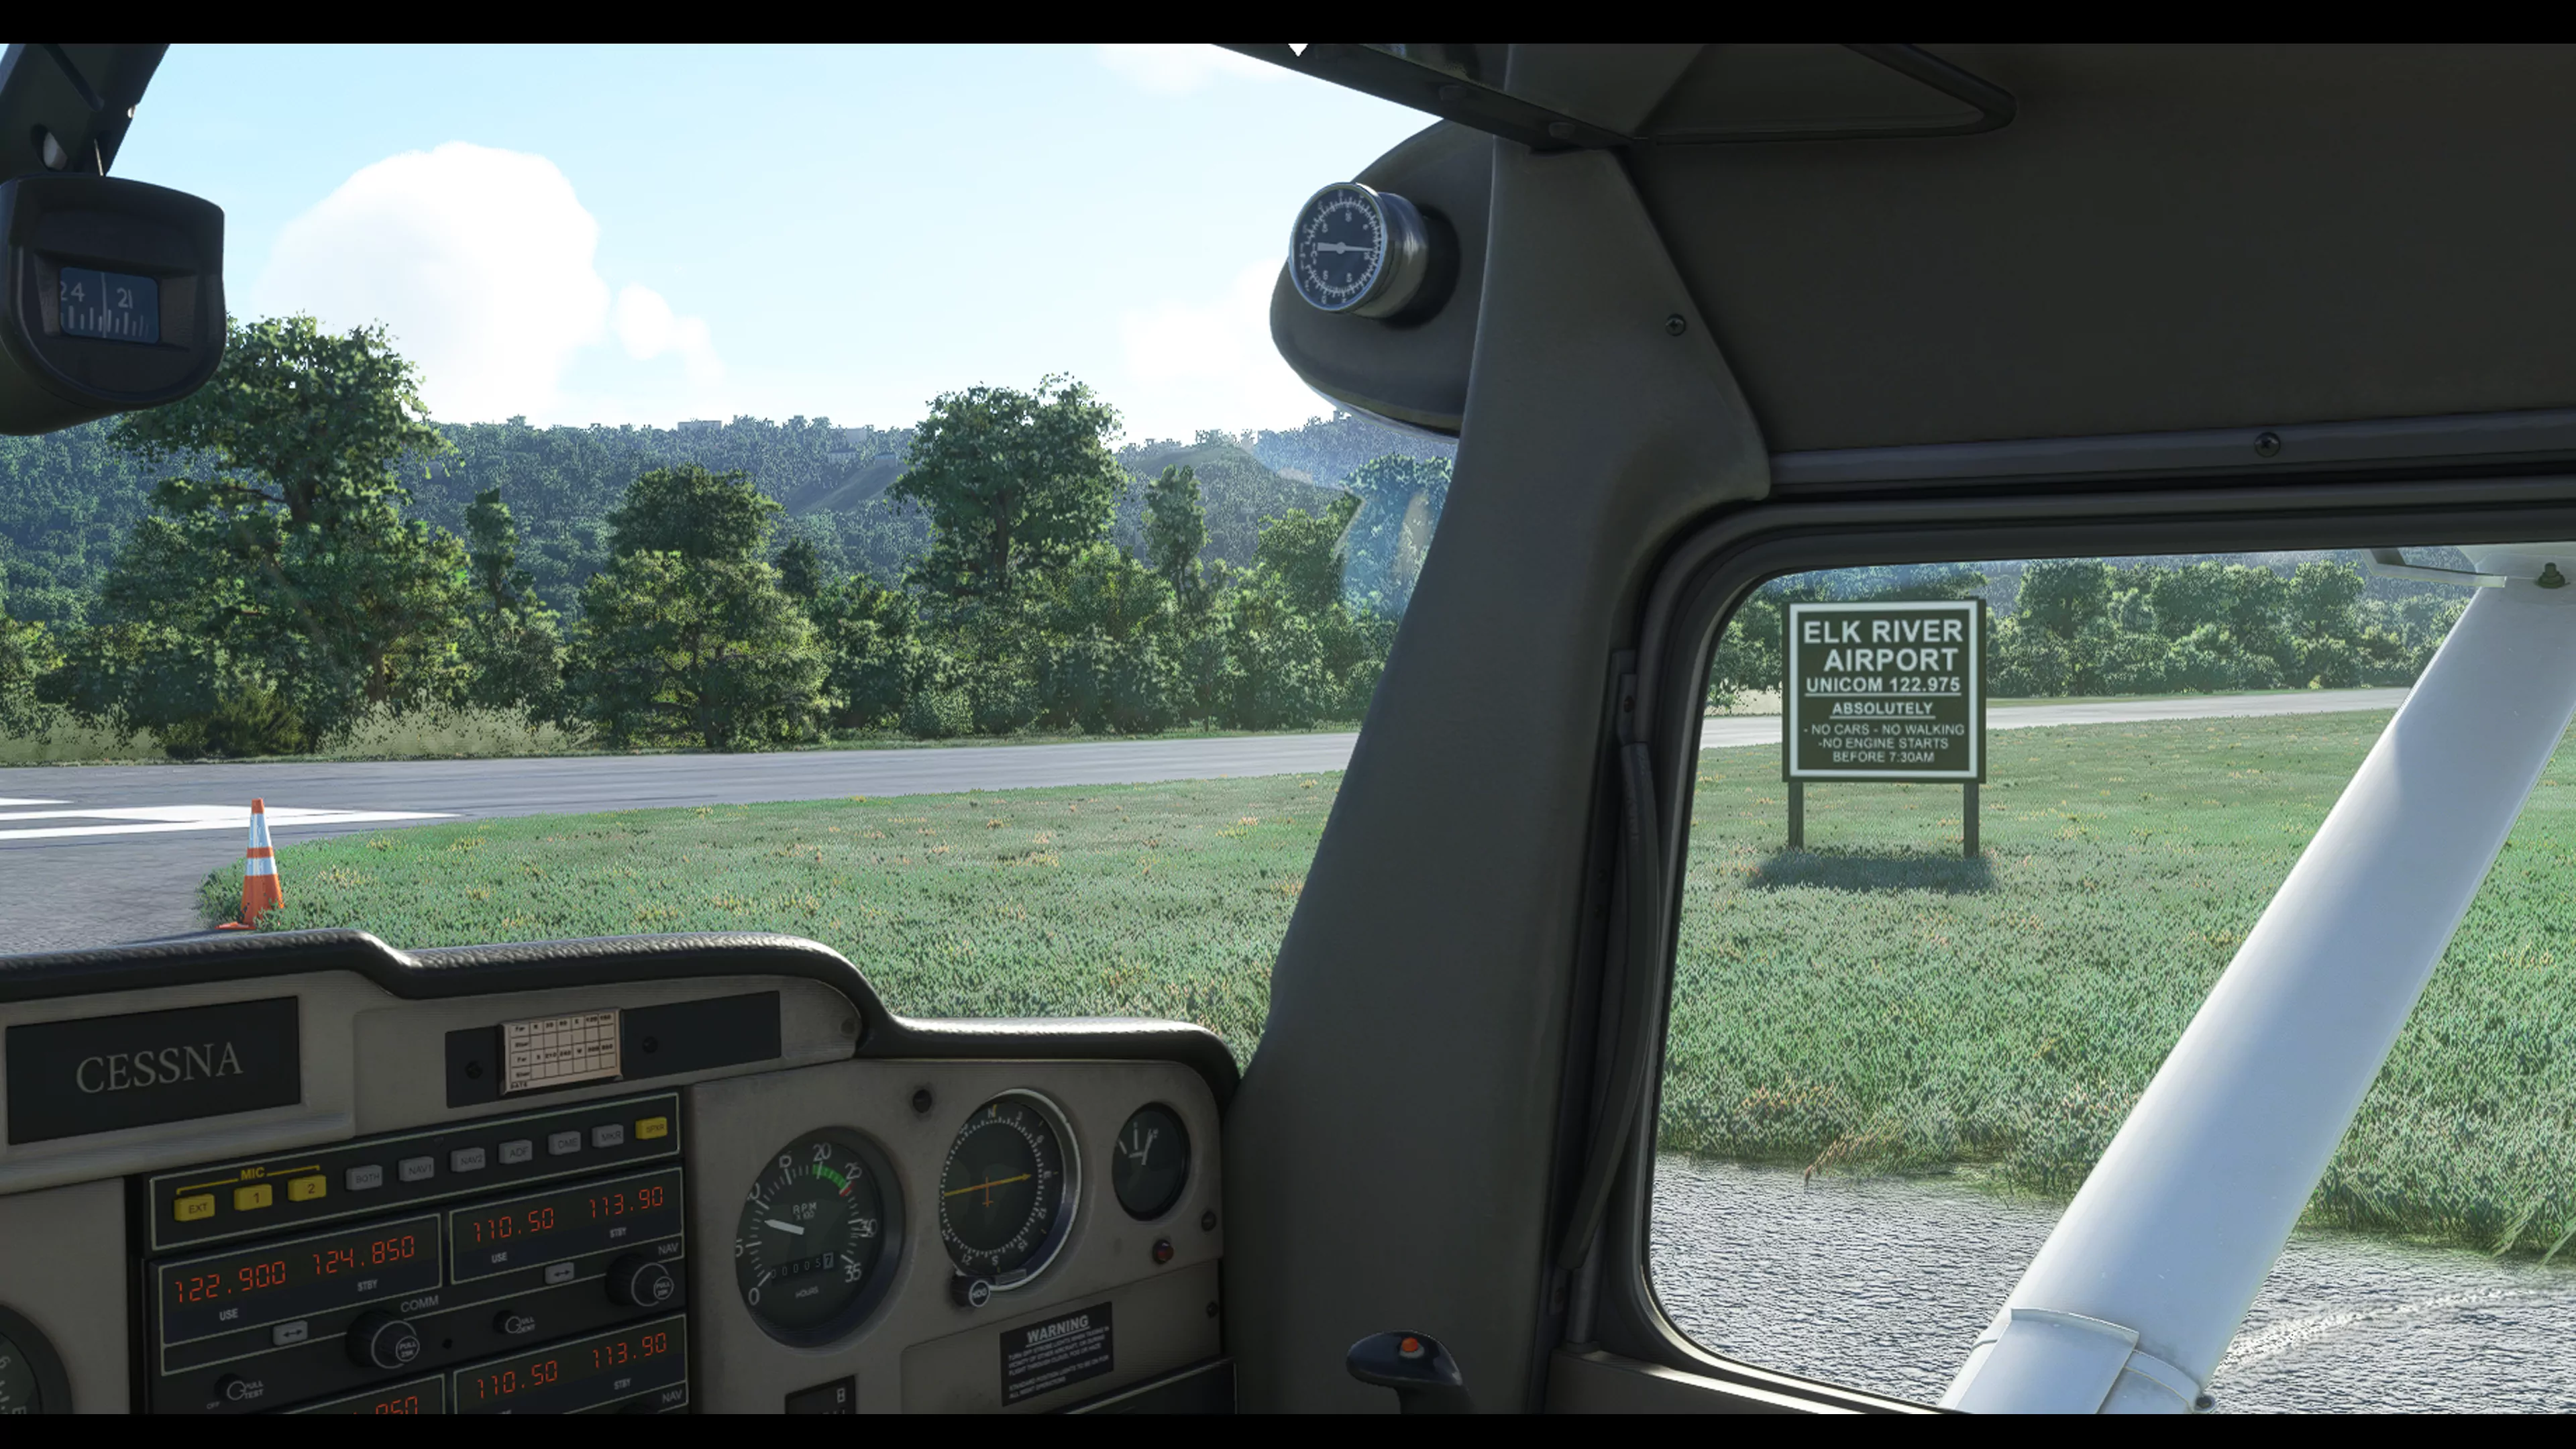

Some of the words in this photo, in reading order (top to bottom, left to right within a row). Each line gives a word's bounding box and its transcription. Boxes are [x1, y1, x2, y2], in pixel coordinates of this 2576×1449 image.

[60, 280, 85, 302] 24
[117, 287, 133, 309] 21
[1804, 621, 1862, 643] ELK
[1872, 619, 1963, 643] RIVER
[1823, 648, 1959, 672] AIRPORT
[1806, 678, 1882, 692] UNICOM
[1889, 677, 1960, 692] 122.975
[1831, 702, 1933, 715] ABSOLUTELY
[1811, 723, 1831, 735] NO
[1834, 723, 1870, 735] CARS
[1882, 723, 1900, 735] NO
[1904, 723, 1965, 735] WALKING
[1845, 738, 1895, 749] ENGINE
[1898, 737, 1949, 749] STARTS
[1833, 751, 1885, 763] BEFORE
[1889, 751, 1935, 763] 7:30AM
[76, 1041, 244, 1094] CESSNA
[813, 1142, 832, 1162] 20
[189, 1201, 209, 1214] EXT
[254, 1192, 260, 1203] 1
[308, 1183, 315, 1195] 2
[356, 1173, 380, 1183] BOTH
[409, 1164, 432, 1175] NAV1
[460, 1155, 483, 1166] NAV2
[508, 1146, 529, 1159] ADF
[557, 1137, 578, 1149] DME
[601, 1130, 622, 1141] MKR
[240, 1167, 265, 1181] MIC
[845, 1162, 862, 1180] 25
[474, 1208, 555, 1243] 110.50
[589, 1186, 664, 1219] 113.90
[792, 1201, 817, 1214] RPM
[657, 1242, 680, 1256] NAV
[492, 1252, 508, 1263] USE
[175, 1260, 286, 1303] 122.900
[312, 1235, 415, 1275] 124.850
[845, 1263, 862, 1283] 35
[357, 1279, 378, 1292] STBY
[795, 1286, 819, 1299] HOURS
[400, 1295, 439, 1313] COMM
[748, 1287, 760, 1306] 0
[219, 1308, 239, 1321] USE
[1027, 1315, 1089, 1343] WARNING
[477, 1360, 558, 1399] 110.50
[592, 1332, 667, 1369] 113.90
[614, 1377, 631, 1390] STBY
[661, 1389, 682, 1403] NAV
[206, 1401, 221, 1410] OFF
